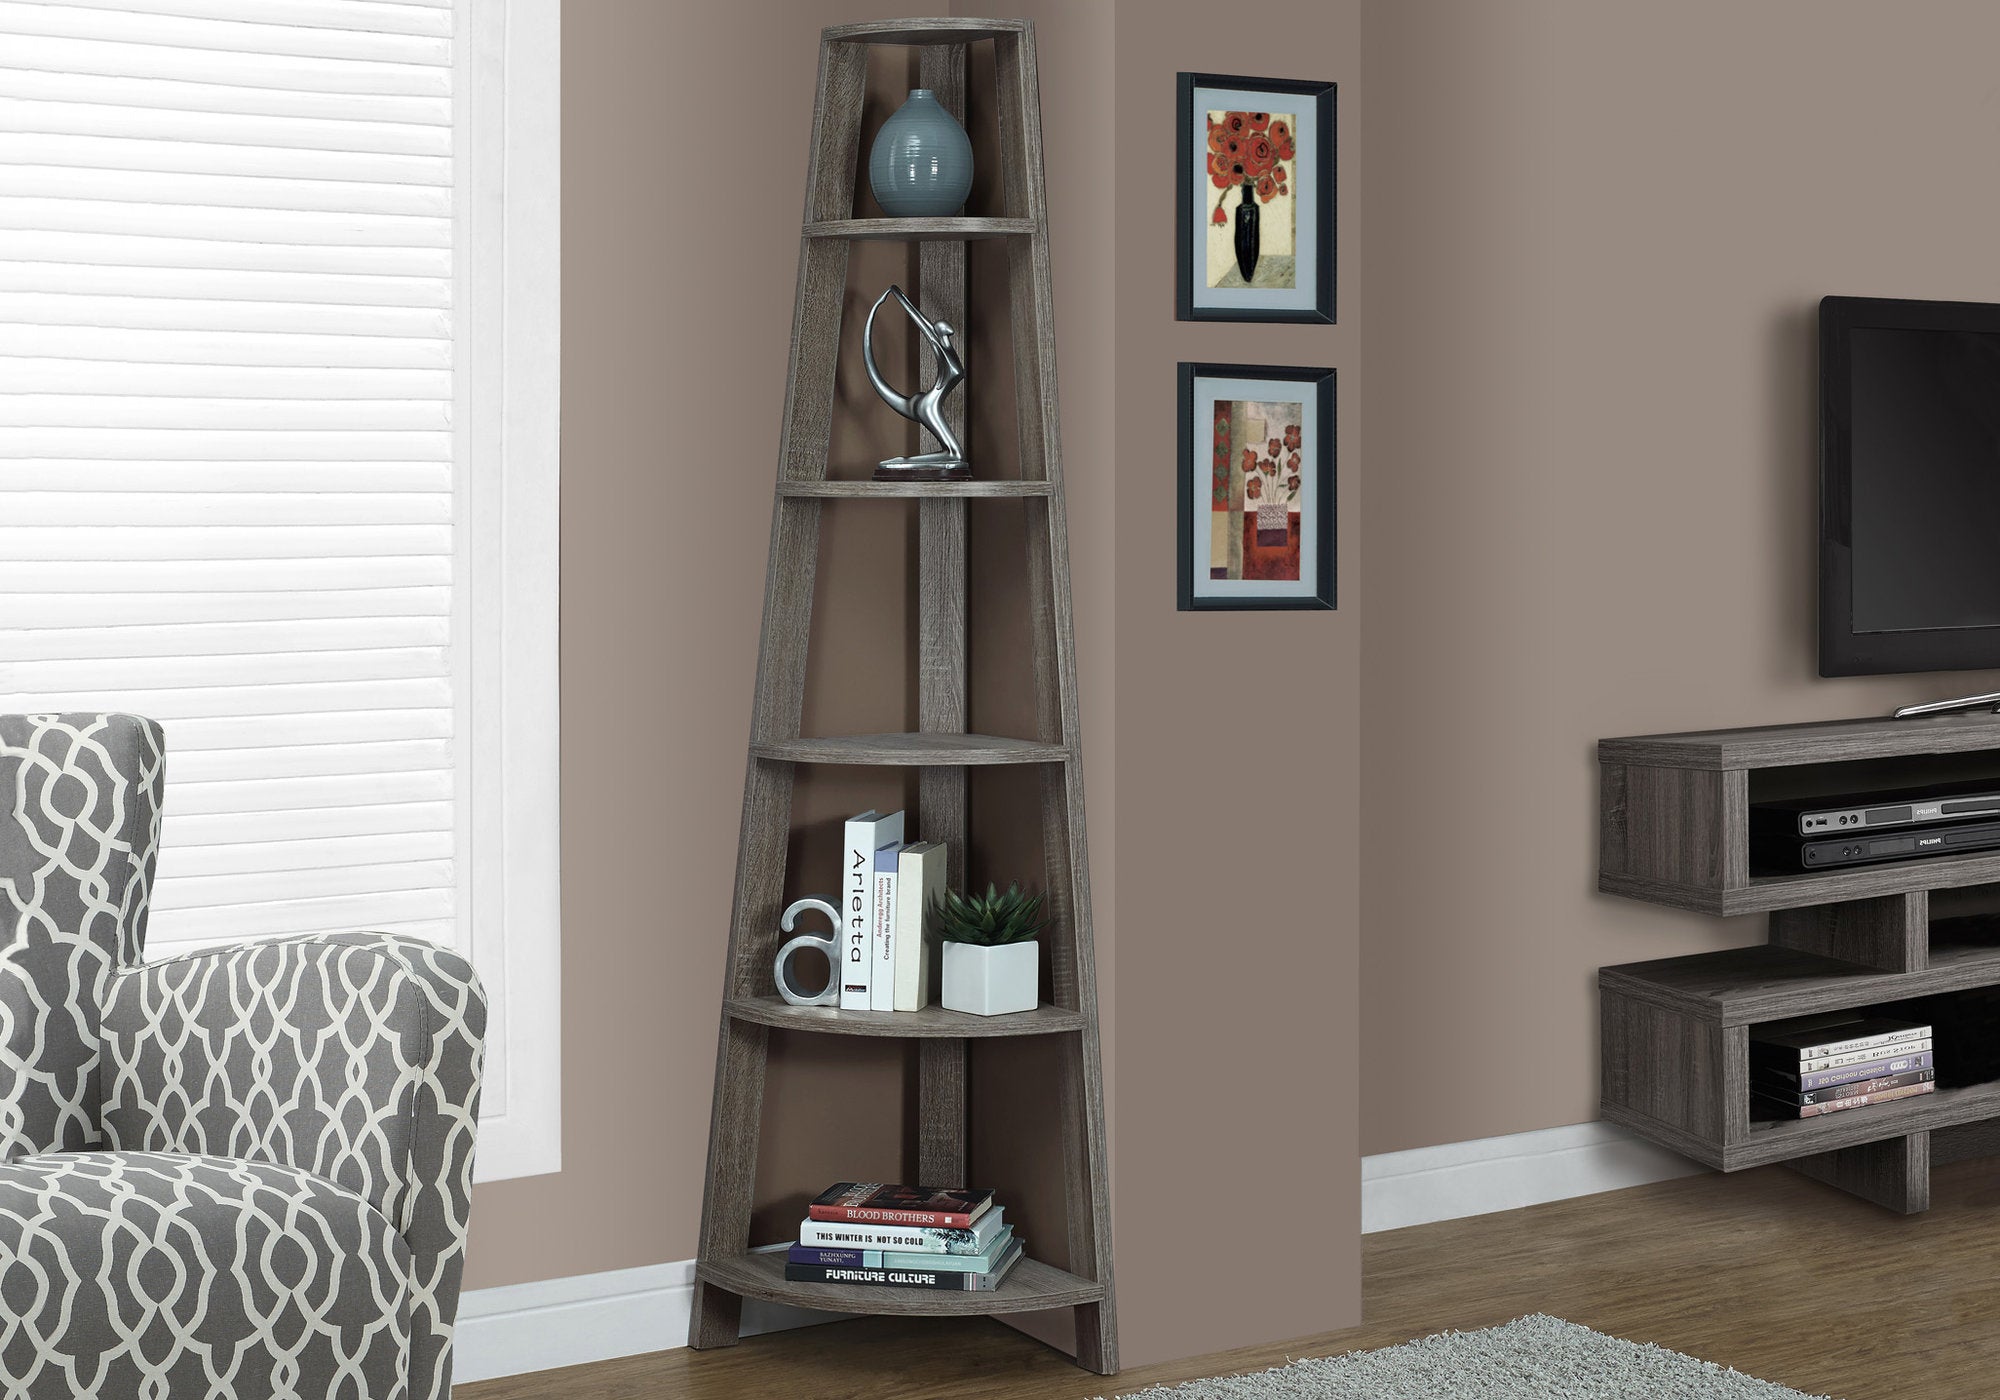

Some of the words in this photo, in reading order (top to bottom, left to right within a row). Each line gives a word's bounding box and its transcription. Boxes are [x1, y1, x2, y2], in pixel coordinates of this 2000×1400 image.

[851, 849, 866, 963] Arletta
[847, 1209, 880, 1220] BLOOD
[882, 1211, 935, 1223] BROTHERS
[816, 1232, 833, 1242] THIS
[835, 1233, 863, 1243] WINTER
[865, 1234, 873, 1243] IS
[876, 1235, 891, 1244] NOT
[892, 1236, 903, 1245] SO
[904, 1236, 924, 1246] COLD
[826, 1269, 885, 1281] FURNITURE
[888, 1272, 936, 1284] CULTURE
